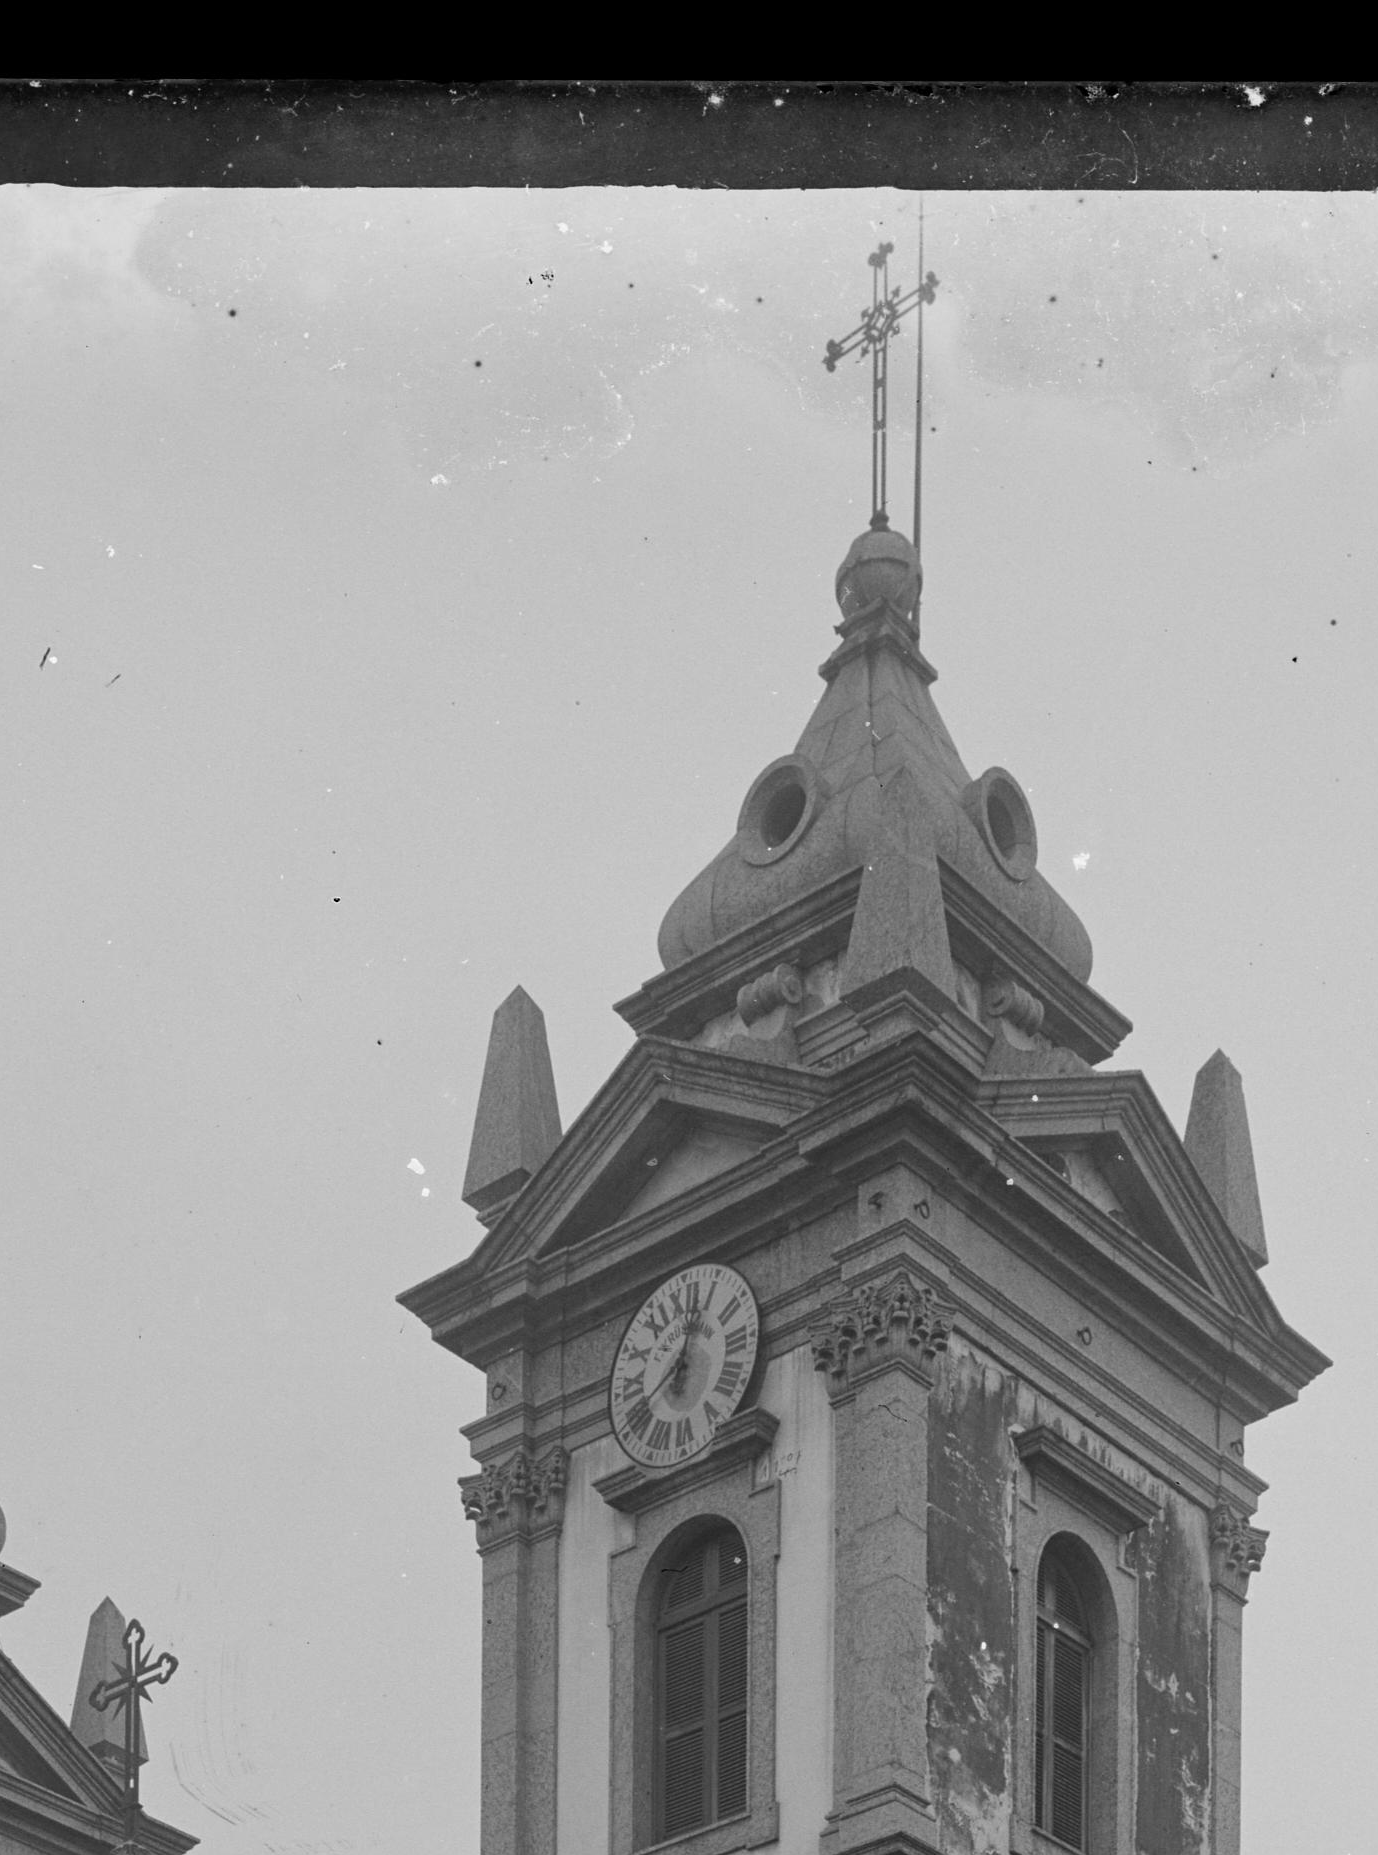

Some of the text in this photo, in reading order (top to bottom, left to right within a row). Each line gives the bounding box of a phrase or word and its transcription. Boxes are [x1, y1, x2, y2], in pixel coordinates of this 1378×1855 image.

[703, 1281, 718, 1311] I
[717, 1294, 742, 1327] II
[642, 1302, 670, 1341] XI
[628, 1345, 652, 1362] X
[725, 1325, 747, 1357] III
[623, 1371, 645, 1402] IX
[713, 1360, 743, 1398] IIII
[646, 1418, 672, 1451] VII
[676, 1417, 694, 1448] VI
